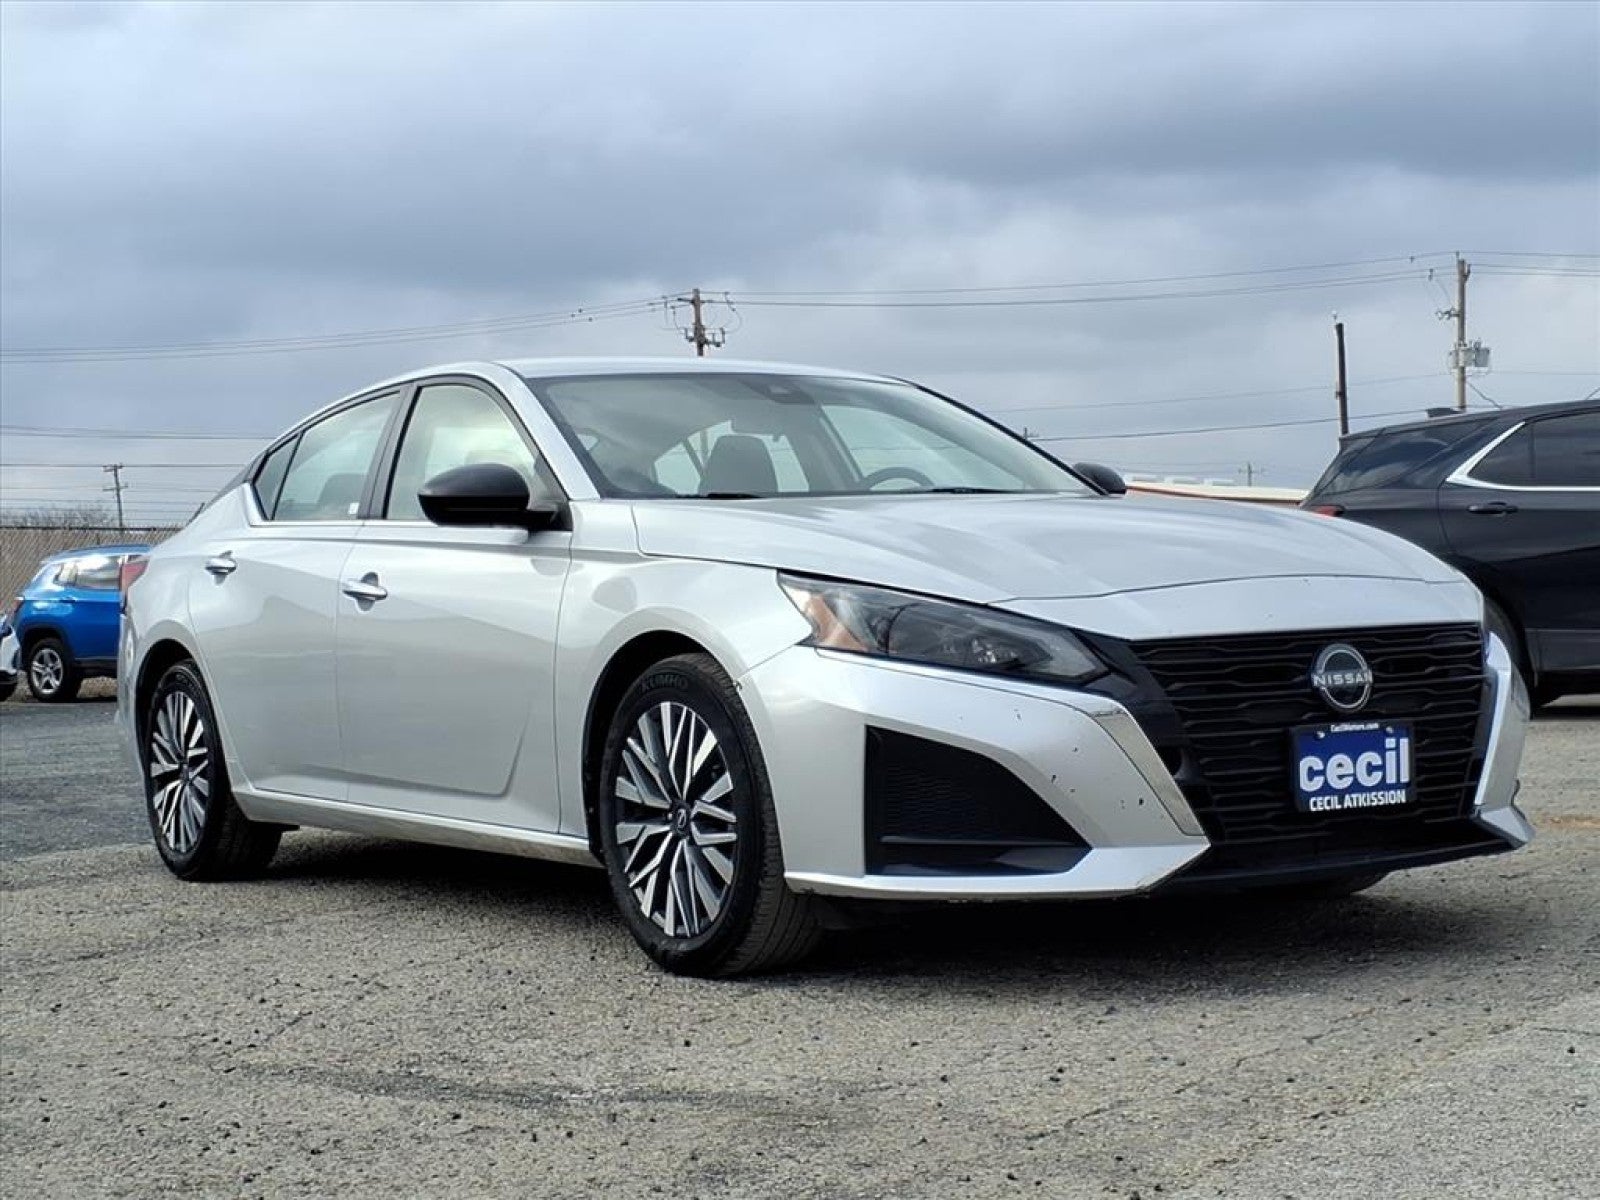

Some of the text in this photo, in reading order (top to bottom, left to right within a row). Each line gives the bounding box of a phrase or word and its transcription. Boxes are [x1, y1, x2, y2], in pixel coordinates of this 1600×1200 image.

[1311, 671, 1373, 687] NISSAN
[1300, 738, 1410, 792] cecil
[1309, 789, 1406, 811] CECIL ATKISSION
